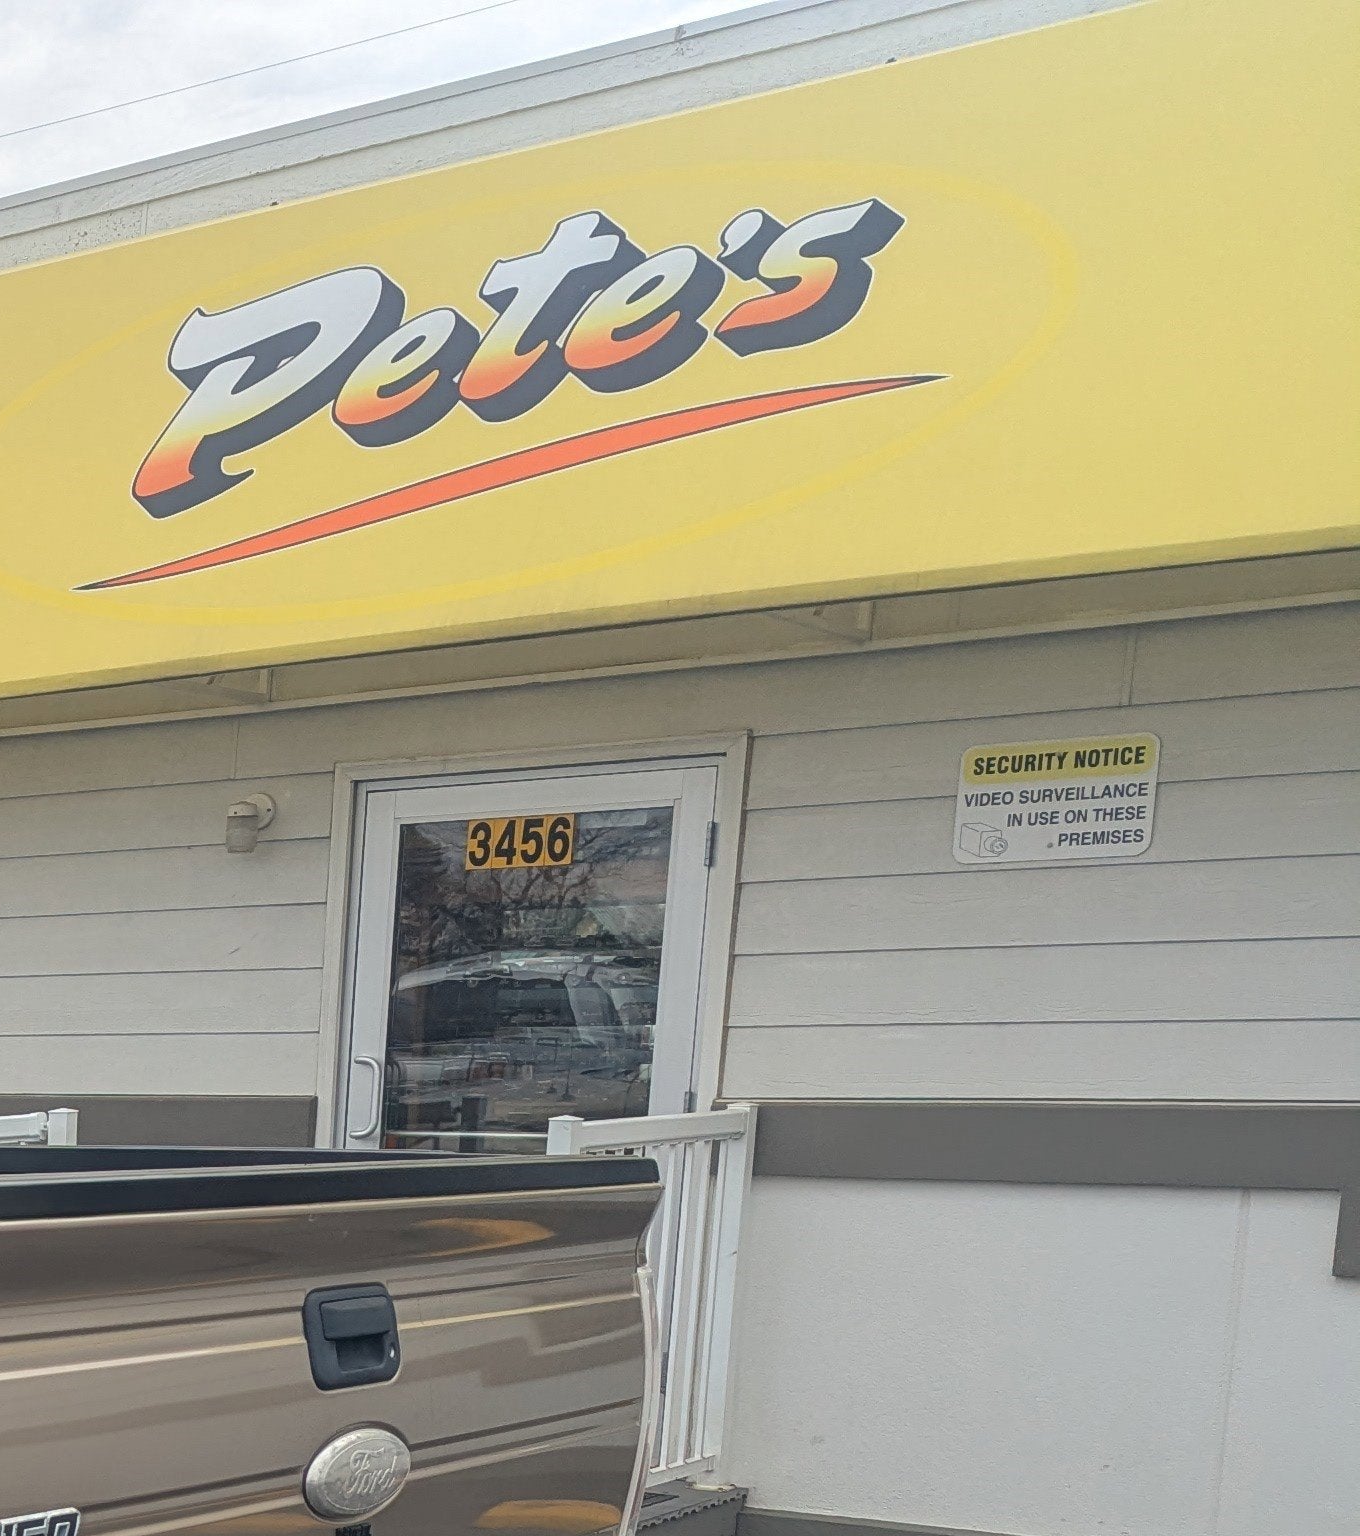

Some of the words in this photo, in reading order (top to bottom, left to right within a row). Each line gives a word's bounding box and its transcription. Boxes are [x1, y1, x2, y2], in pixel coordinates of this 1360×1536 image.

[131, 198, 906, 519] Pete's
[973, 751, 1069, 776] SECURITY
[1073, 745, 1147, 769] NOTICE
[964, 791, 1014, 808] VIDEO
[1018, 782, 1150, 805] SURVEILLANCE
[1006, 813, 1023, 828] IN
[1027, 810, 1060, 826] USE
[1064, 809, 1088, 824] ON
[1092, 805, 1147, 823] THESE
[467, 815, 572, 867] 3456
[1057, 828, 1145, 847] PREMISES
[339, 1446, 398, 1499] Ford
